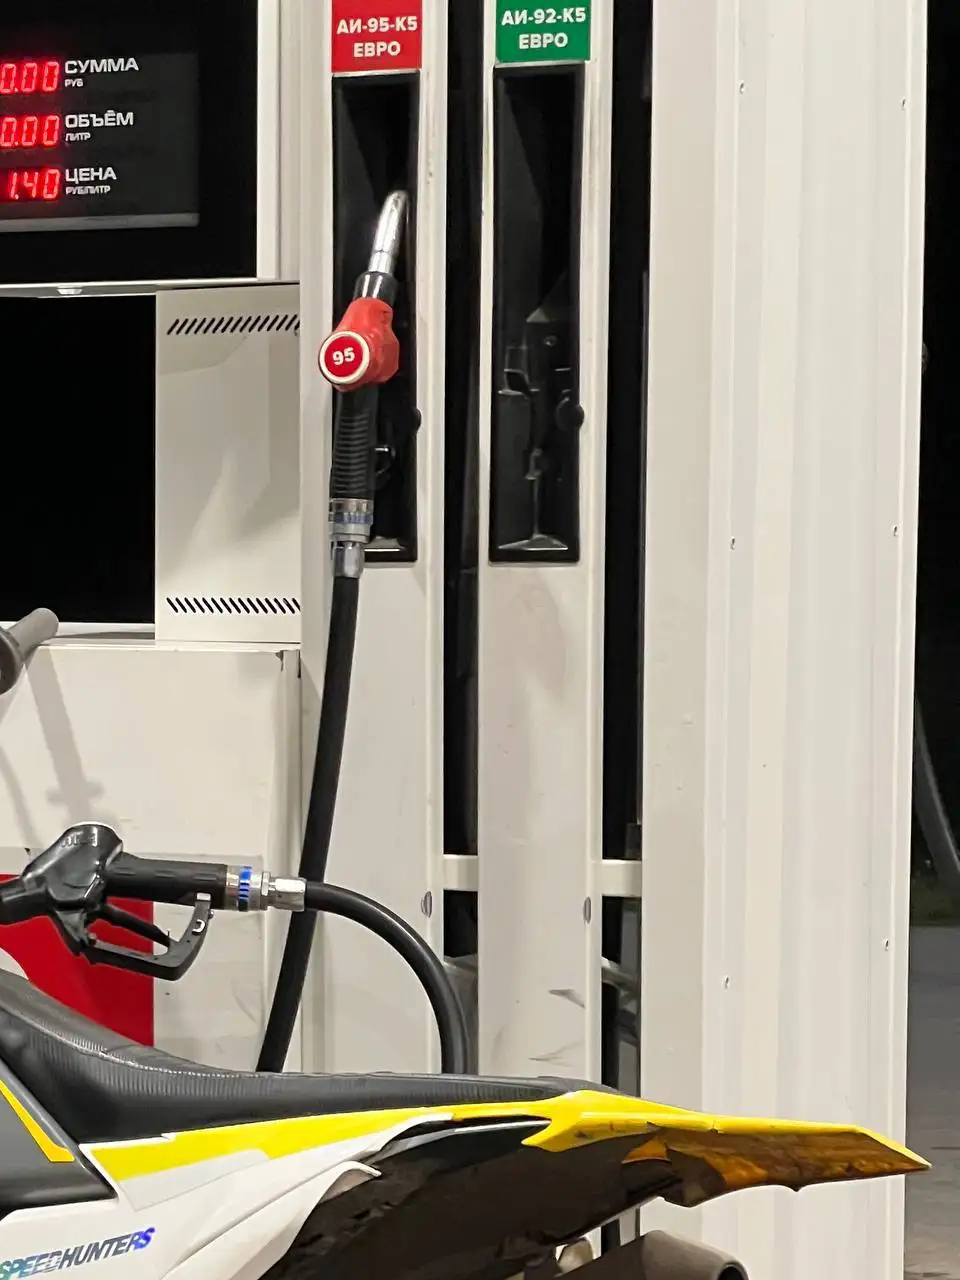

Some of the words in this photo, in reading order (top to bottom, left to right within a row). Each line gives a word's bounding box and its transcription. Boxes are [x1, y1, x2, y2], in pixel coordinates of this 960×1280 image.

[336, 15, 418, 35] АИ-95-К5
[501, 7, 587, 26] АИ-92-К5
[353, 40, 401, 58] ЕВРО
[518, 32, 569, 50] ЕВРО
[64, 57, 139, 74] СУММА
[64, 78, 84, 88] РУБ
[65, 109, 134, 129] ОБЪЁМ
[65, 132, 91, 142] ЛИТР
[65, 166, 117, 184] ЦЕНА
[332, 346, 356, 366] 95
